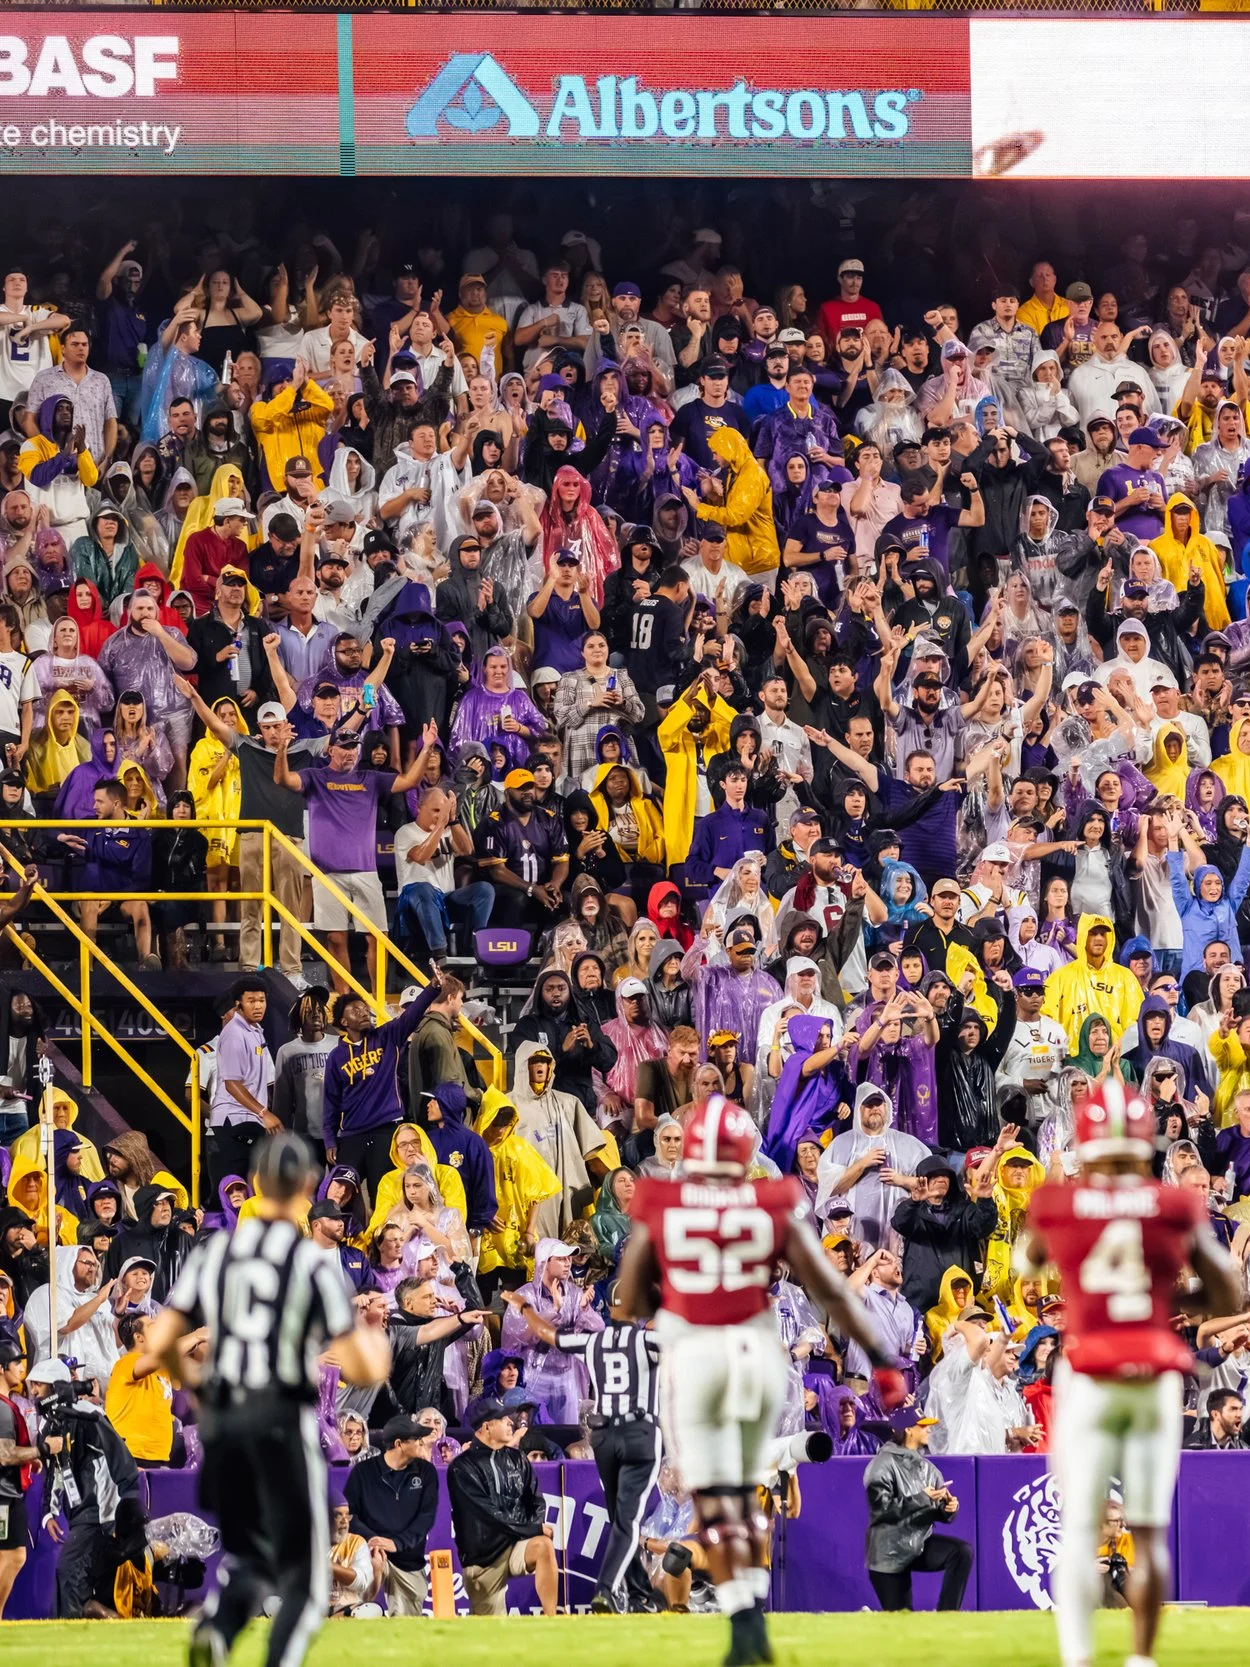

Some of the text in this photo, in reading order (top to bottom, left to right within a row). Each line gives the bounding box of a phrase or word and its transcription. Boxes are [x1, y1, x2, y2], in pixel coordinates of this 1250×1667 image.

[0, 36, 180, 97] BASF
[547, 75, 910, 140] Albertsons
[31, 118, 181, 154] chemistry
[630, 613, 654, 649] 18
[1108, 750, 1137, 764] LSU
[486, 837, 495, 849] 11
[753, 827, 765, 835] LSU
[377, 843, 397, 855] LS
[519, 852, 540, 883] 11
[488, 941, 518, 953] LSU
[1090, 980, 1115, 995] LSU
[1071, 1003, 1089, 1016] LS
[1014, 1029, 1058, 1049] LSU
[341, 1047, 385, 1081] TIGERS
[1028, 1056, 1057, 1065] TIGERS
[663, 1208, 775, 1295] 52
[1081, 1219, 1152, 1323] 4
[224, 1256, 282, 1341] C
[603, 1352, 630, 1394] B
